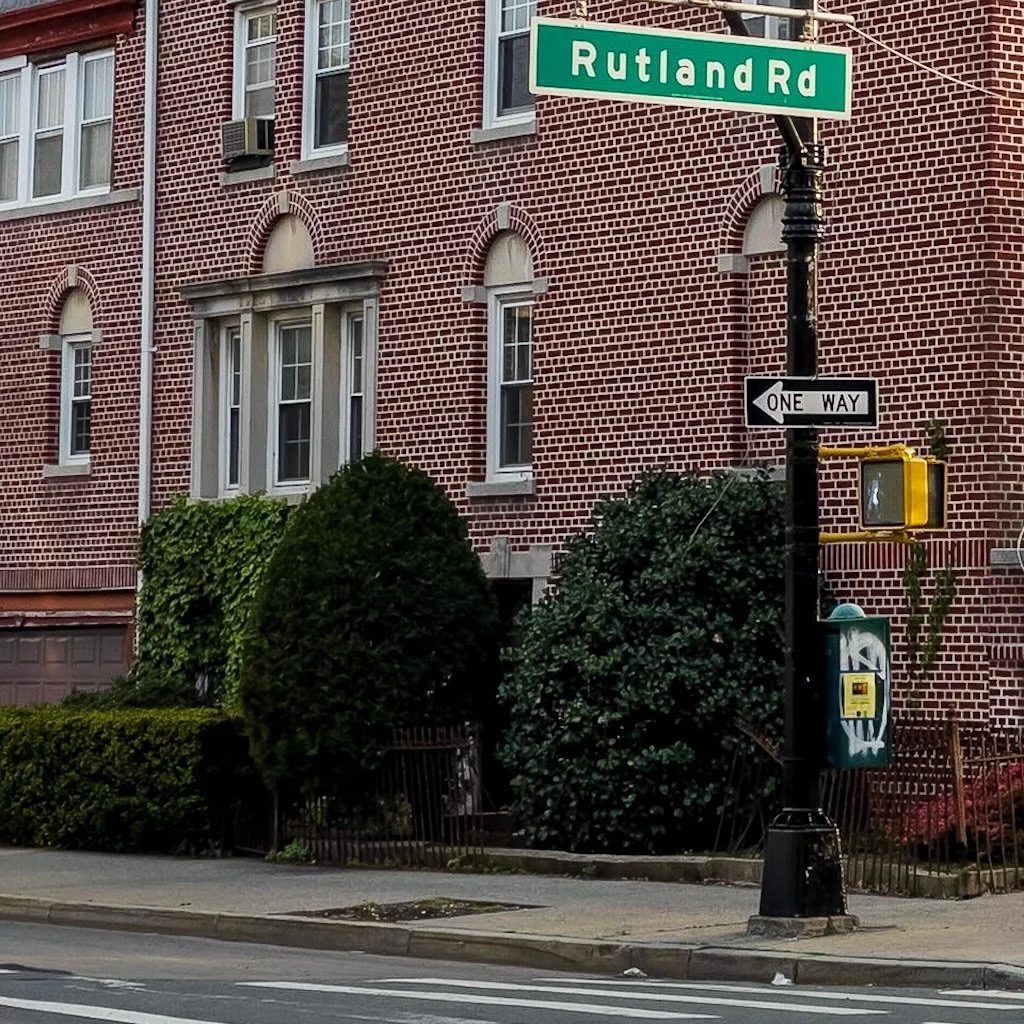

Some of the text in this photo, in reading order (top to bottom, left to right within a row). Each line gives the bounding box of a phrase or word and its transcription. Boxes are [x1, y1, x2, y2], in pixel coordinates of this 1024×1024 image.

[571, 40, 817, 97] Rutland Rd
[767, 393, 860, 412] ONE WAY
